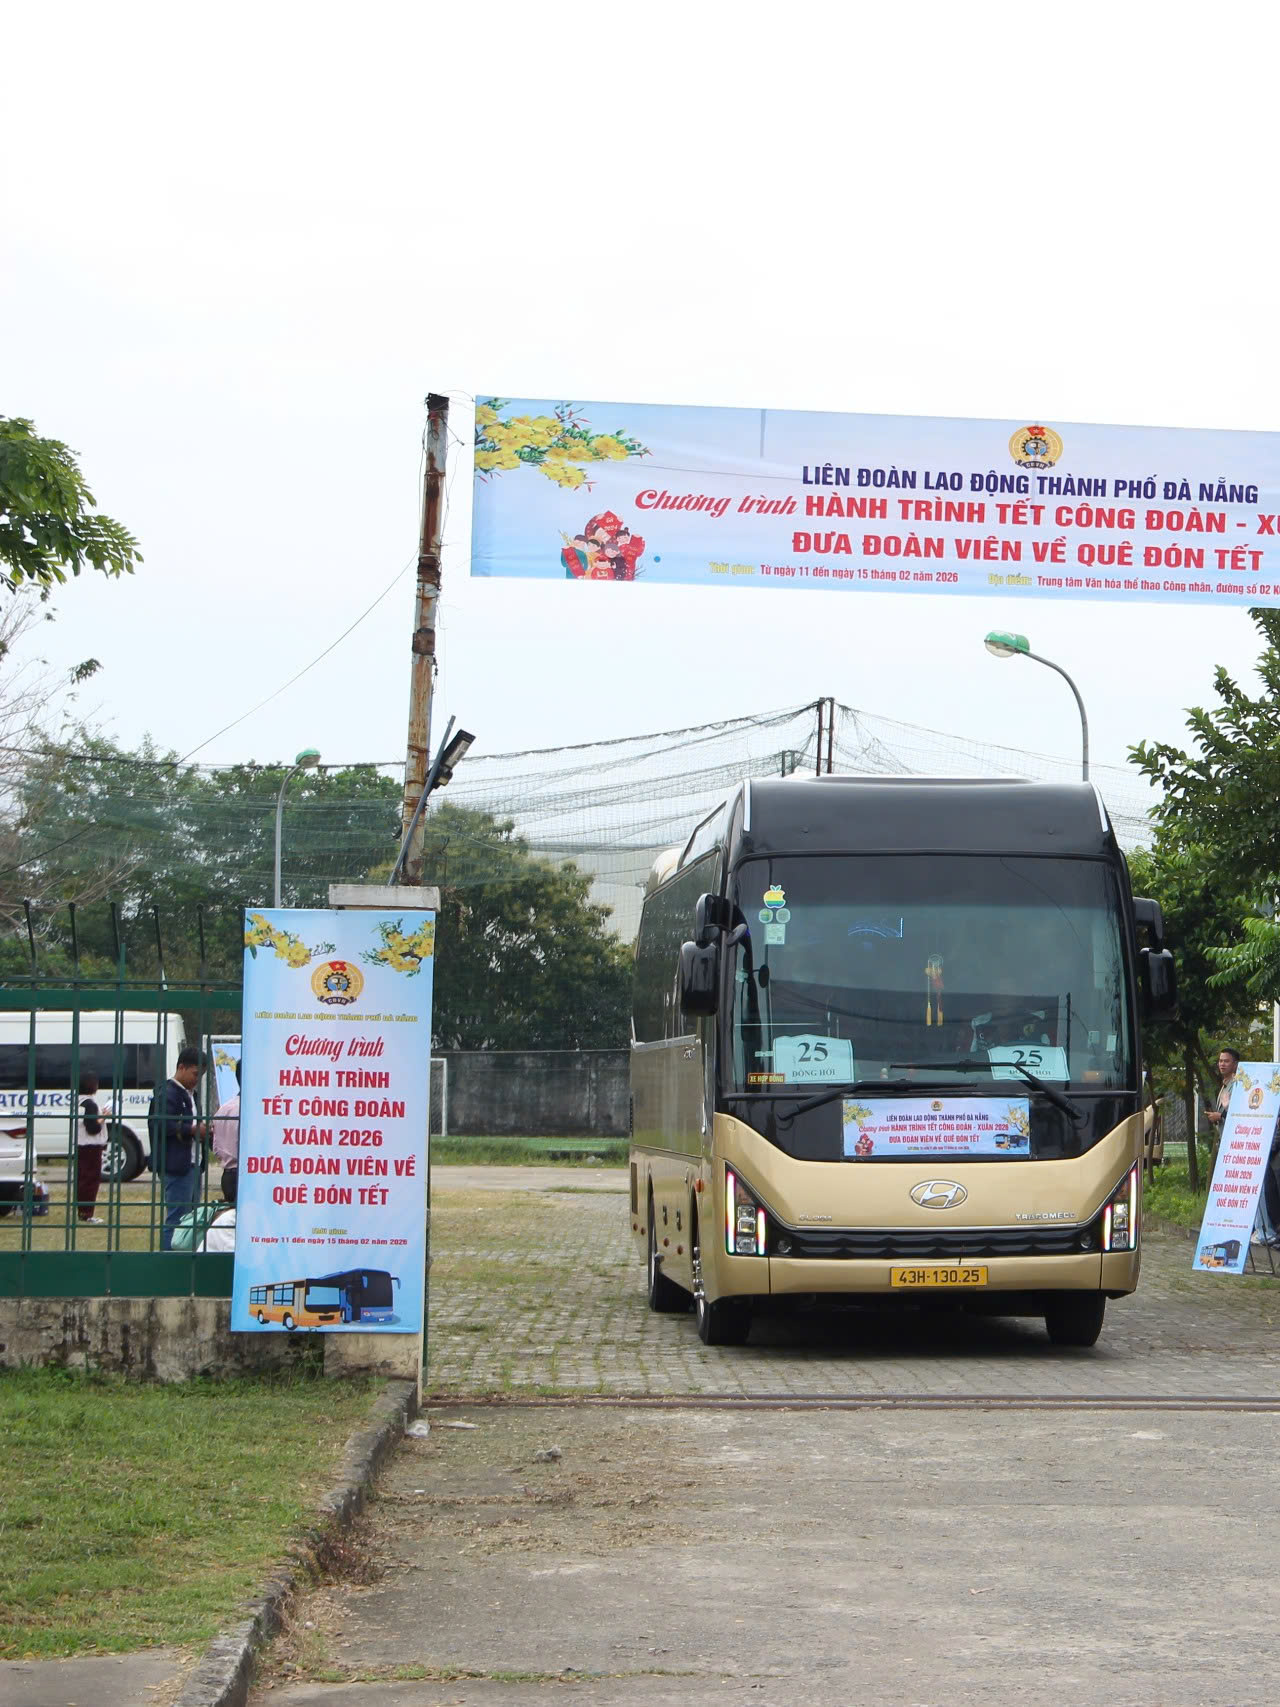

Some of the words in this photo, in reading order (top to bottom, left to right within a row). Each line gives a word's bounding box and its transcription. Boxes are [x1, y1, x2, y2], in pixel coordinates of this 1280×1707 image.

[802, 463, 850, 486] LIÊN
[857, 466, 917, 489] ĐOÀN
[924, 471, 963, 491] LAO
[970, 470, 1029, 495] ĐỘNG
[1036, 473, 1106, 497] THÀNH
[1114, 474, 1157, 499] PHỐ
[1163, 478, 1191, 501] ĐÀ
[1199, 477, 1258, 504] NẴNG
[635, 489, 732, 518] Chương
[737, 495, 797, 515] trình
[806, 492, 887, 519] HÀNH
[898, 496, 985, 523] TRÌNH
[995, 500, 1046, 525] TẾT
[1055, 502, 1135, 529] CÔNG
[1145, 507, 1226, 533] ĐOÀN
[792, 531, 852, 554] ĐƯA
[862, 532, 944, 558] ĐOÀN
[954, 535, 1022, 561] VIÊN
[1032, 537, 1066, 563] VỀ
[1077, 541, 1133, 567] QUÊ
[1143, 543, 1204, 569] ĐÓN
[1214, 544, 1264, 571] TẾT
[760, 564, 772, 575] Từ
[774, 565, 796, 577] ngày
[799, 566, 809, 576] 11
[812, 566, 830, 577] đến
[832, 568, 854, 579] ngày
[857, 569, 868, 579] 15
[871, 569, 896, 581] tháng
[899, 570, 911, 580] 02
[913, 571, 933, 581] năm
[936, 572, 958, 582] 2026
[1037, 576, 1063, 588] Trung
[1065, 577, 1082, 587] tâm
[1085, 578, 1102, 588] Văn
[1105, 578, 1121, 589] hóa
[1124, 577, 1139, 590] thể
[1141, 580, 1160, 590] thao
[1163, 581, 1186, 592] Công
[1188, 582, 1213, 593] nhân,
[1216, 583, 1244, 595] đường
[1246, 583, 1257, 594] số
[1259, 584, 1271, 595] 02
[285, 1034, 344, 1062] Chương
[347, 1036, 384, 1057] trình
[798, 1042, 828, 1062] 25
[1012, 1050, 1042, 1064] 25
[279, 1066, 329, 1087] HÀNH
[335, 1068, 389, 1088] TRÌNH
[262, 1094, 293, 1115] TẾT
[299, 1096, 349, 1117] CÔNG
[354, 1097, 405, 1118] ĐOÀN
[282, 1125, 333, 1145] XUÂN
[338, 1129, 383, 1147] 2026
[247, 1155, 284, 1174] ĐƯA
[289, 1155, 340, 1175] ĐOÀN
[346, 1155, 388, 1176] VIÊN
[394, 1154, 416, 1176] VỀ
[273, 1184, 308, 1205] QUÊ
[314, 1184, 352, 1205] ĐÓN
[358, 1183, 389, 1205] TẾT
[899, 1270, 980, 1284] 43H-130.25
